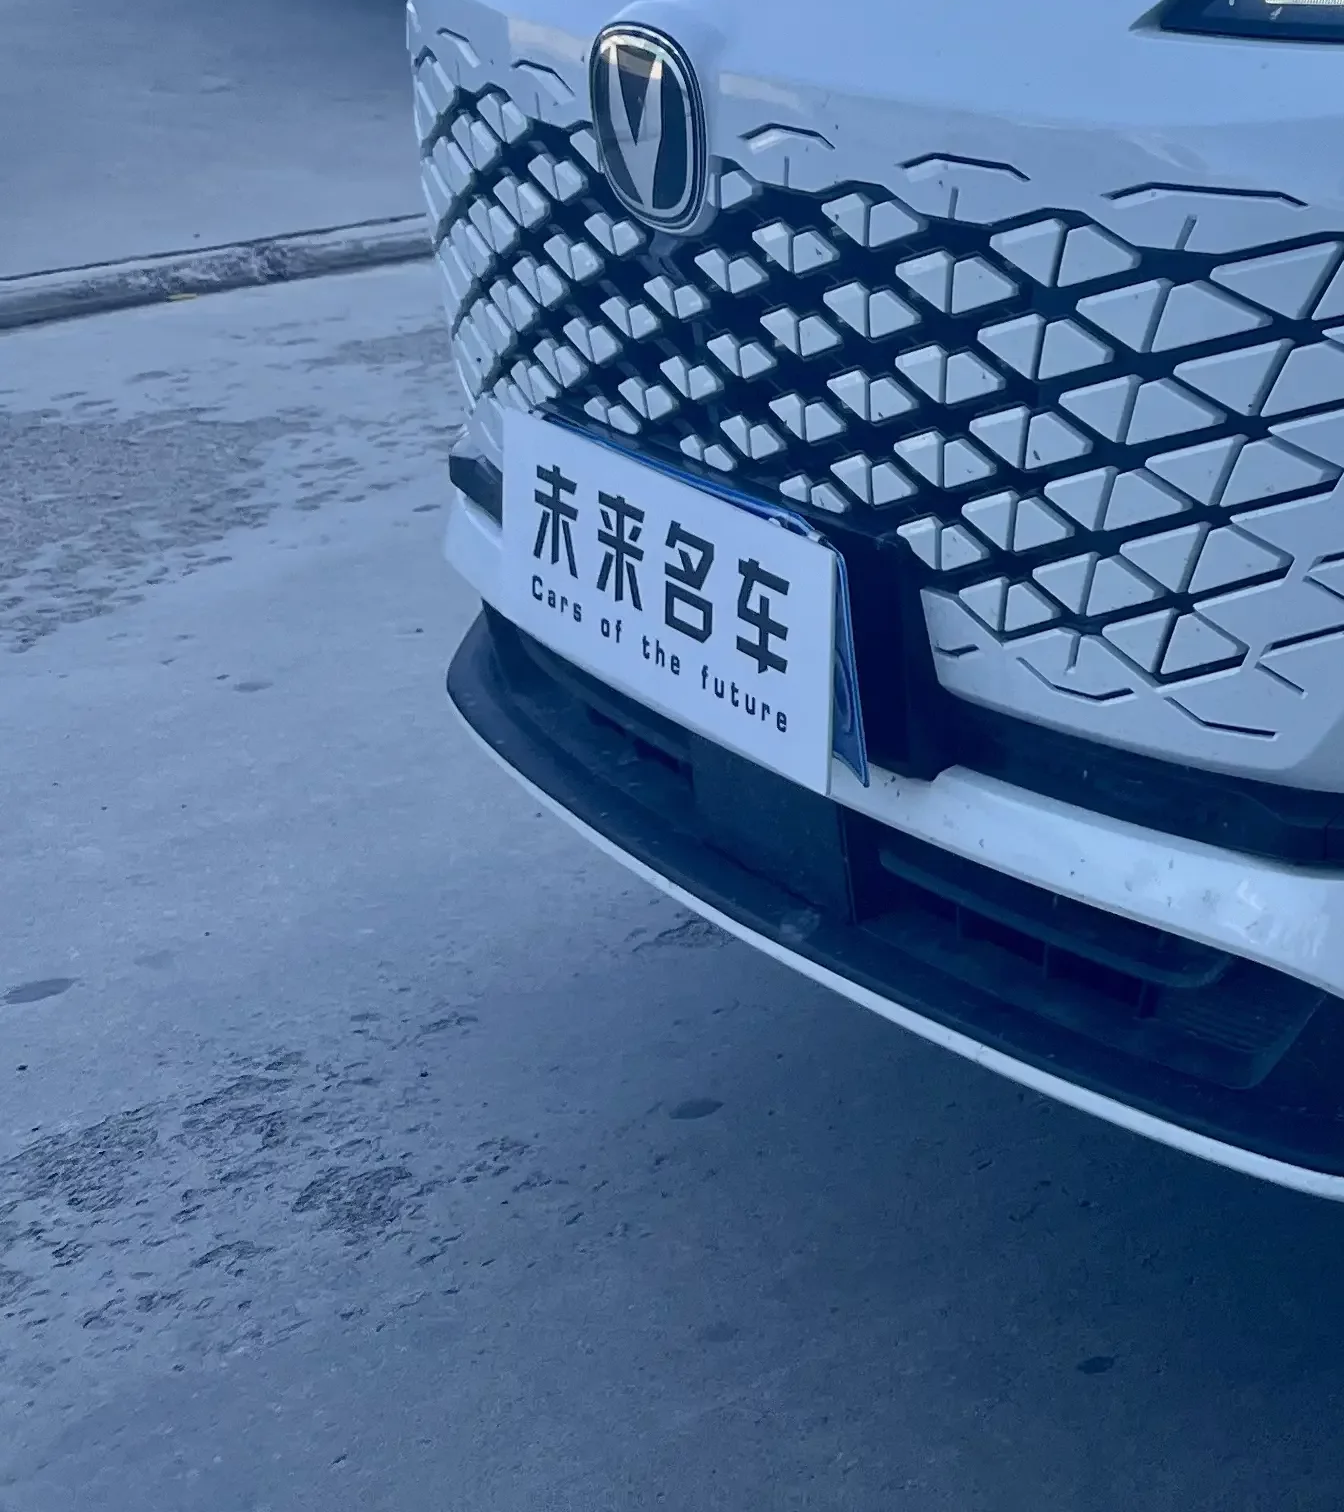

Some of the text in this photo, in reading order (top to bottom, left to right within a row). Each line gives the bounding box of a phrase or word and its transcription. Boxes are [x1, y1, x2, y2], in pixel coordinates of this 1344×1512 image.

[532, 575, 787, 732] Cars of the future
[533, 464, 790, 674] 未来名车
